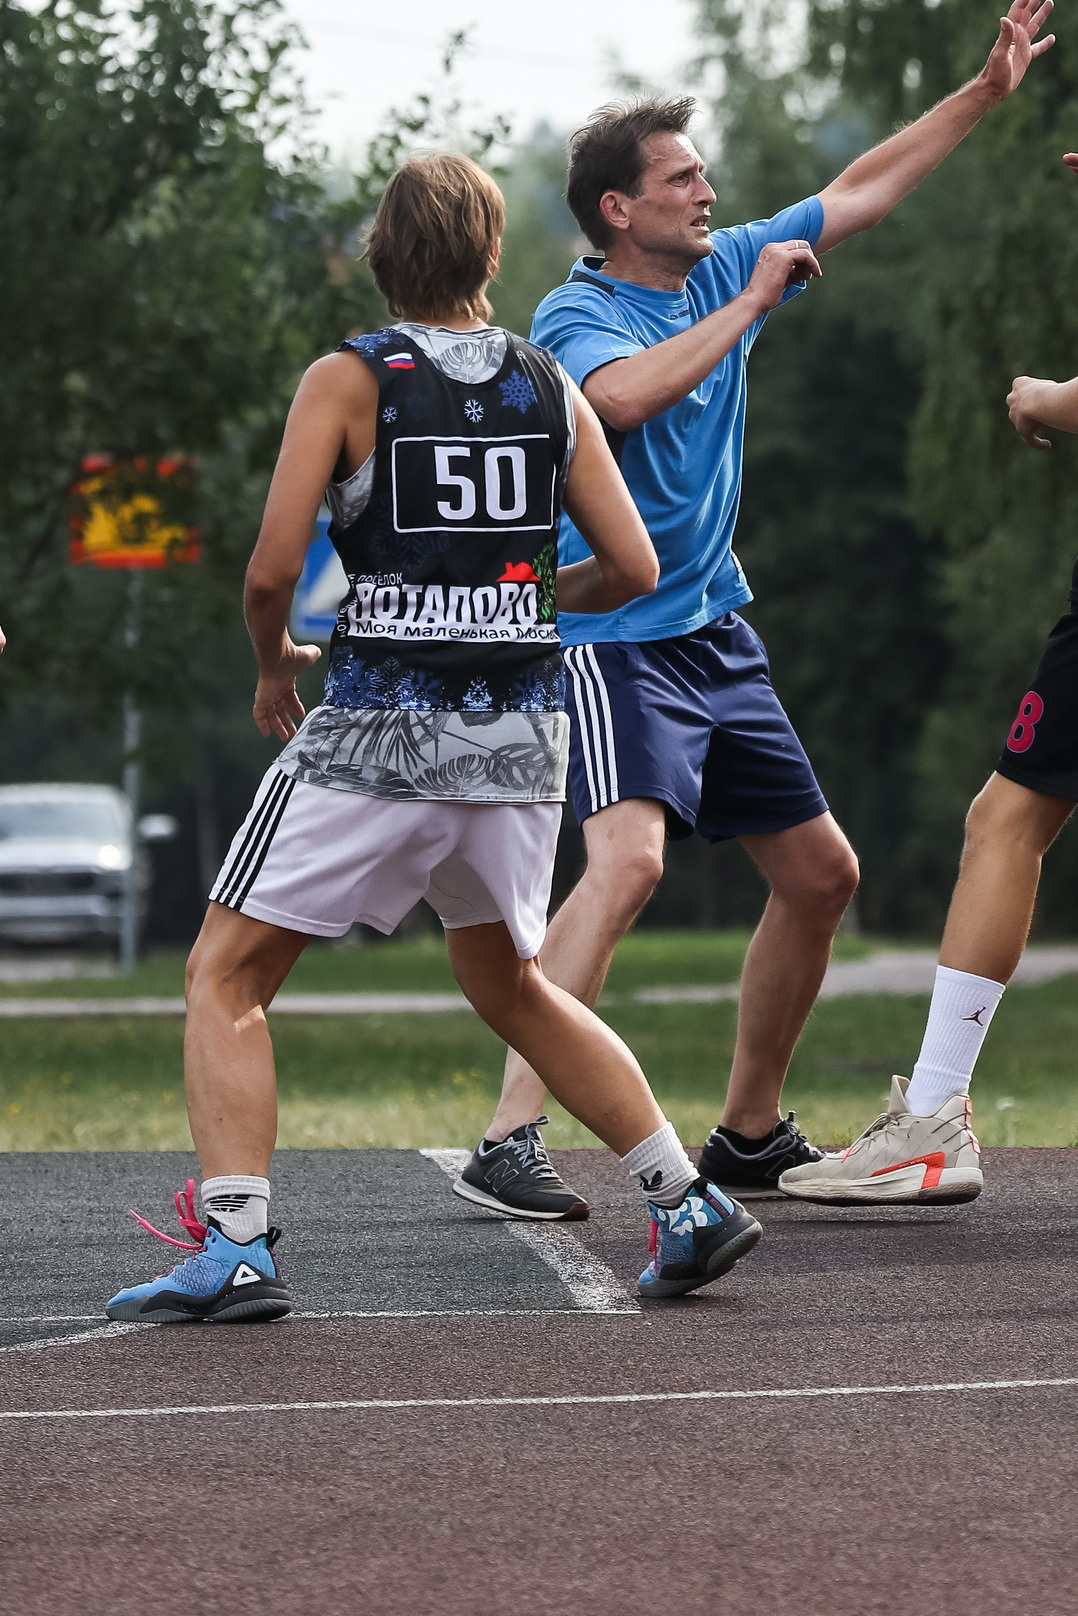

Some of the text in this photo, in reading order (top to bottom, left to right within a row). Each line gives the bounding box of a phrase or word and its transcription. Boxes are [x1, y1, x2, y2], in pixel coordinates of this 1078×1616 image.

[434, 445, 527, 520] 50
[356, 621, 397, 636] Моя
[404, 626, 511, 640] маленькая
[1006, 690, 1044, 754] 8
